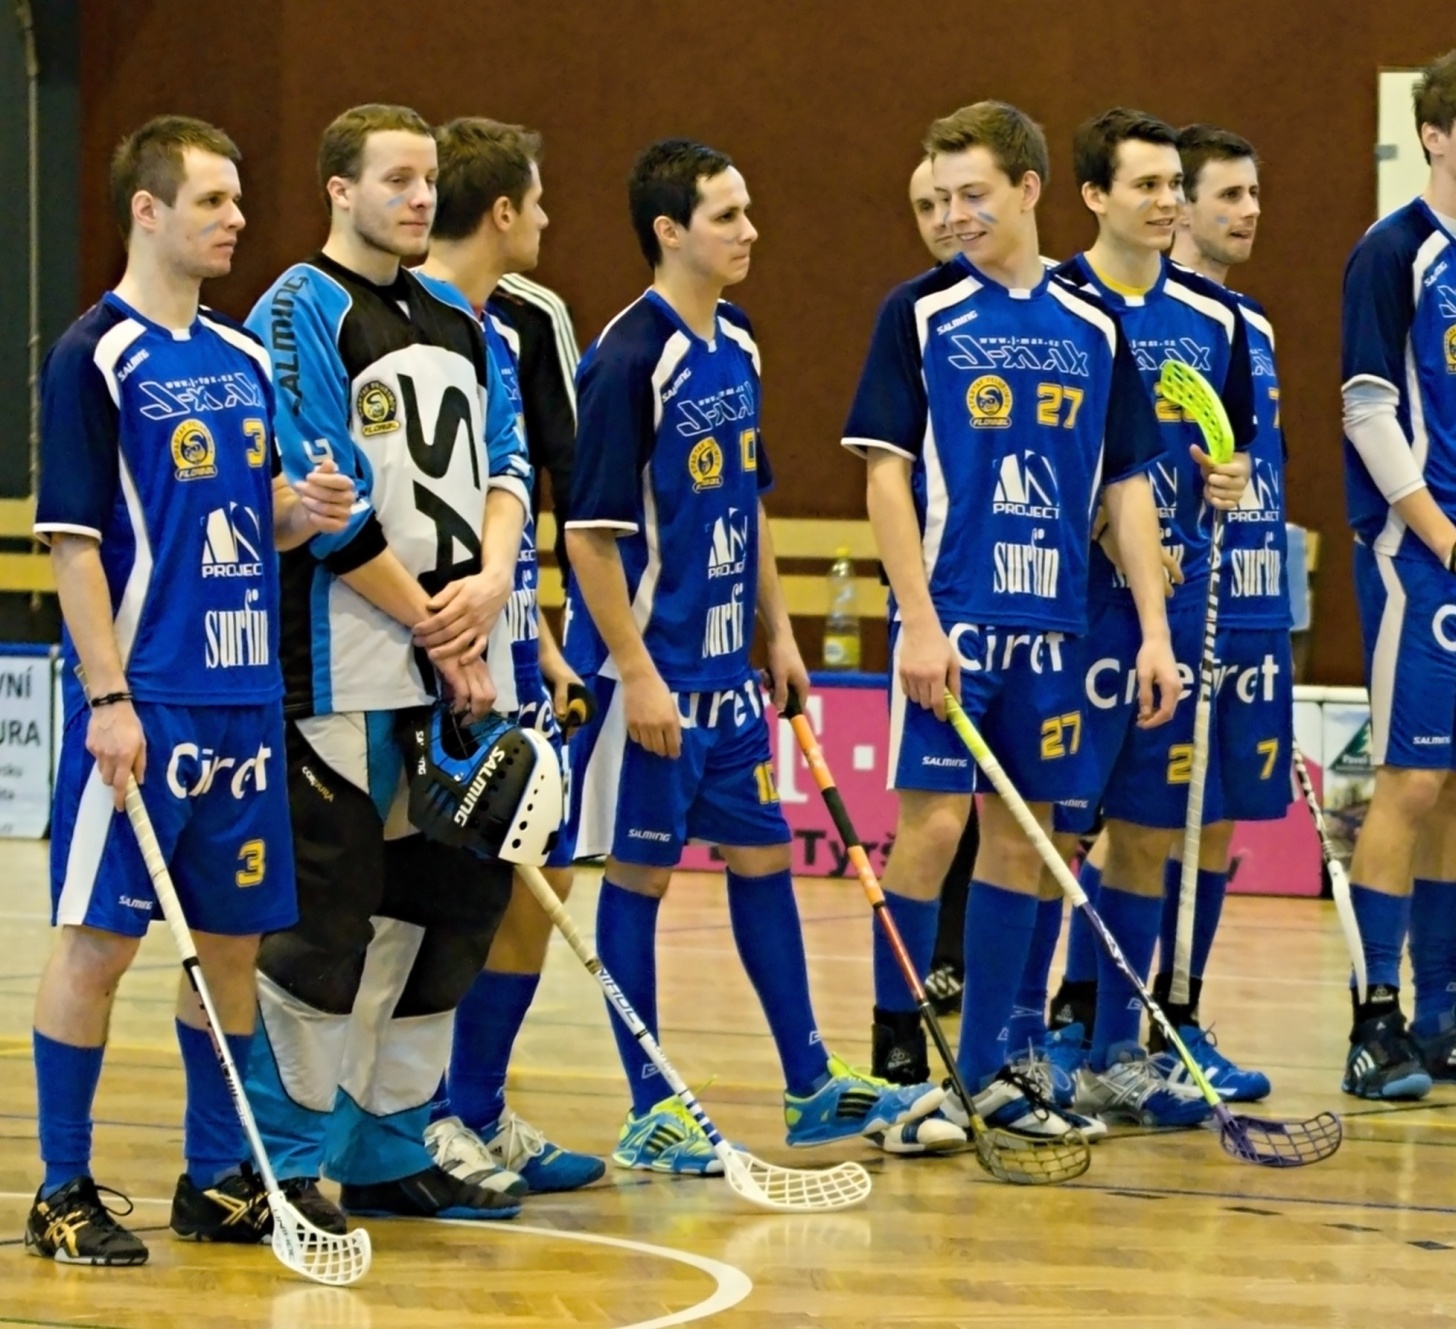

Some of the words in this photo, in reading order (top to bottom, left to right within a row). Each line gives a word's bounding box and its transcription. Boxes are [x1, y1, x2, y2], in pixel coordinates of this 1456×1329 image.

[1036, 382, 1085, 429] 27
[243, 418, 267, 467] 3
[993, 503, 1061, 519] PROJECT
[202, 562, 262, 578] PROJEC
[0, 665, 33, 699] VNÍ
[1039, 711, 1082, 761] 27
[166, 742, 271, 800] Ciret
[922, 755, 968, 768] SALMING
[1256, 738, 1279, 780] 7
[454, 746, 505, 826] SALMING
[628, 828, 671, 843] SALMING
[235, 839, 266, 888] 3
